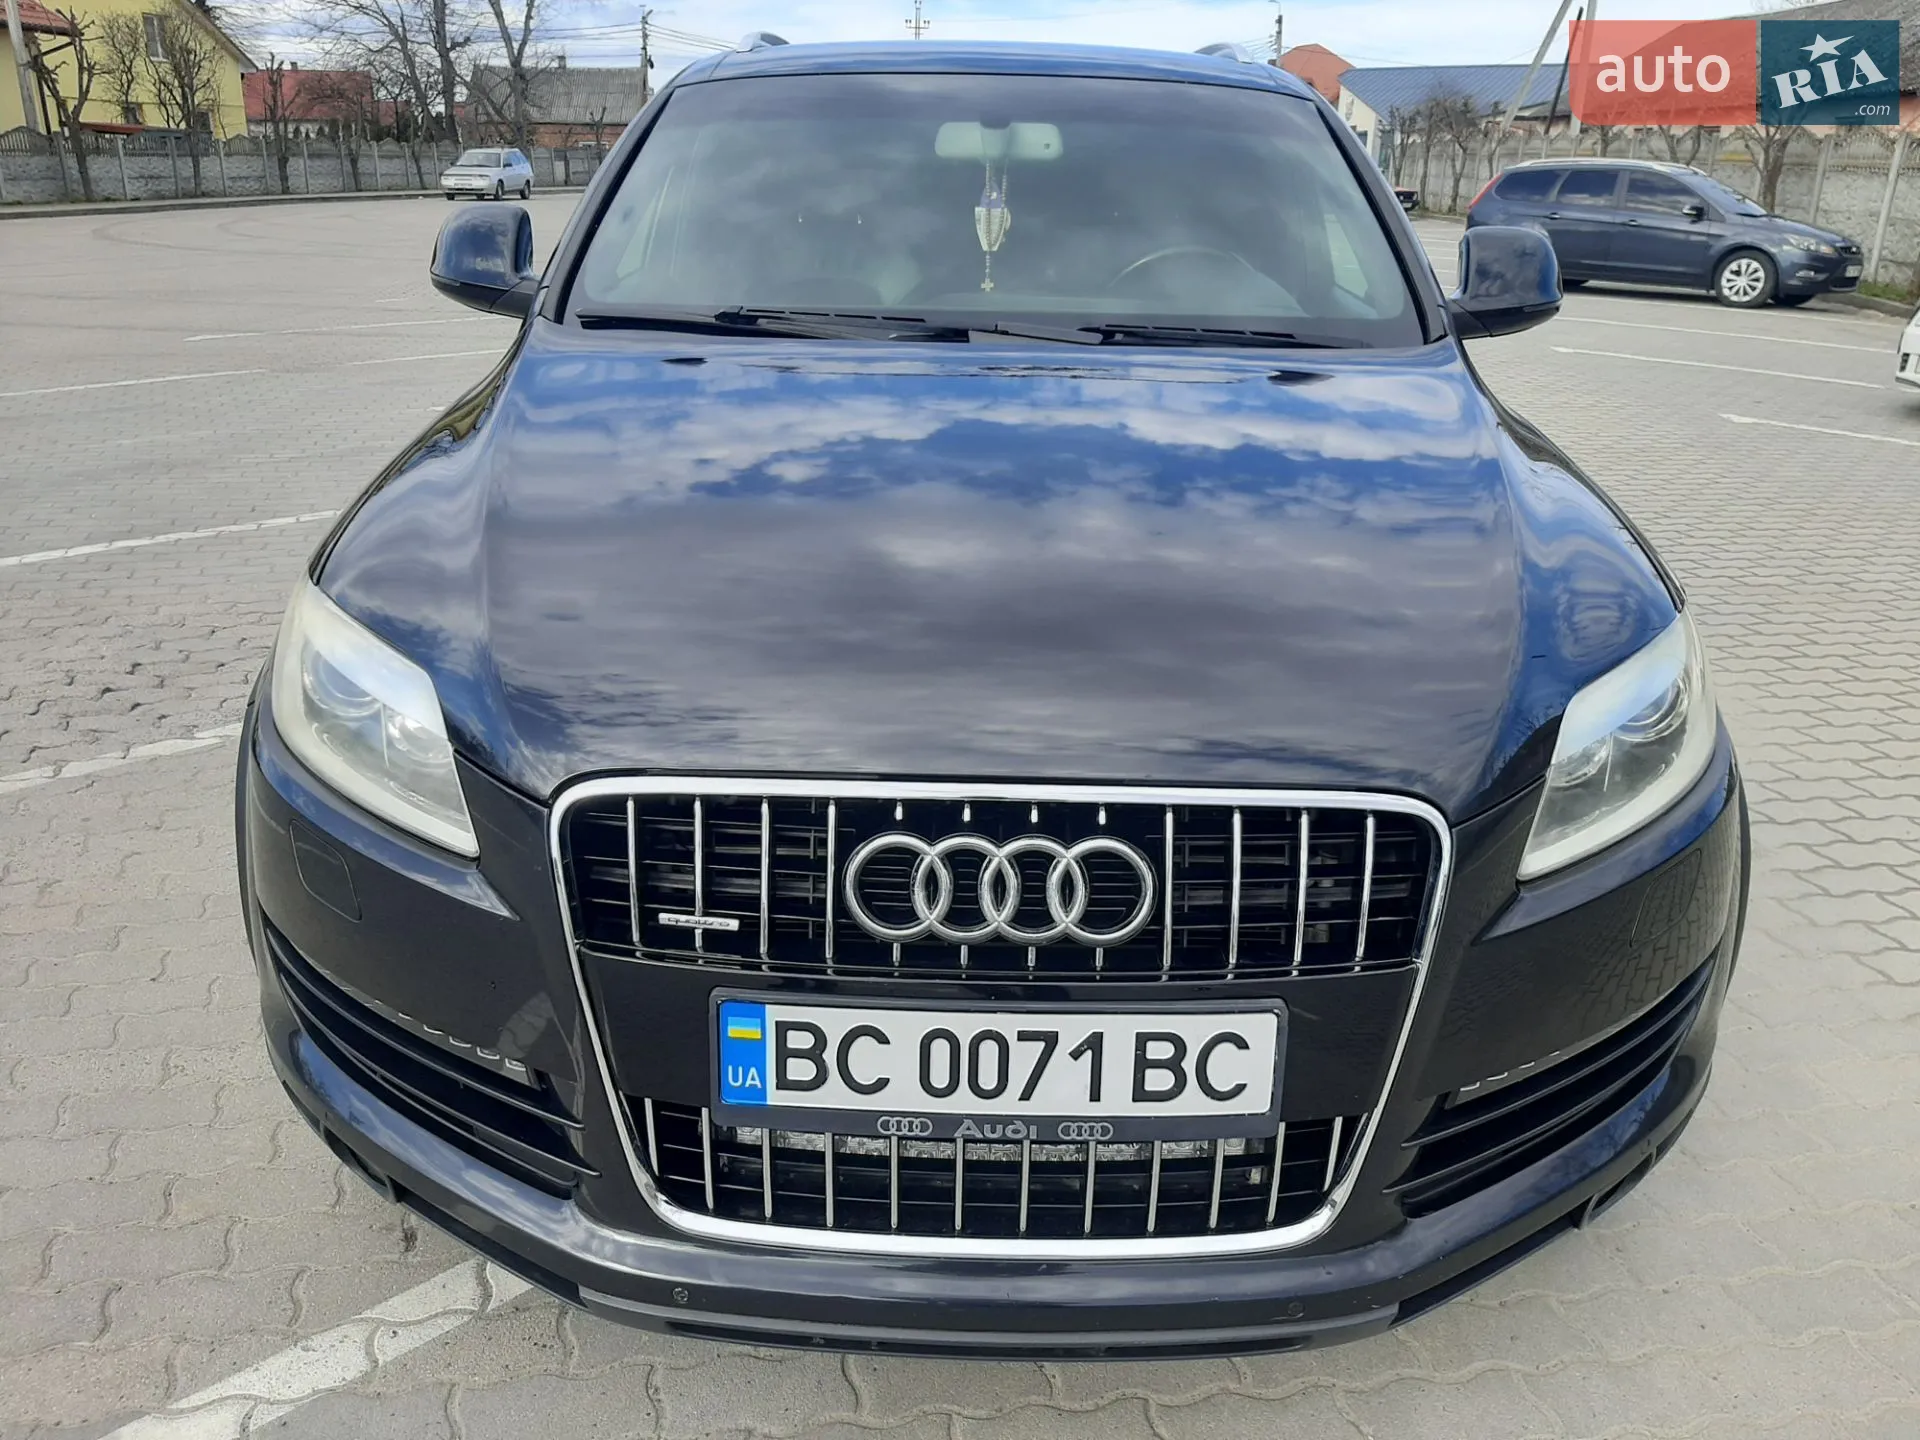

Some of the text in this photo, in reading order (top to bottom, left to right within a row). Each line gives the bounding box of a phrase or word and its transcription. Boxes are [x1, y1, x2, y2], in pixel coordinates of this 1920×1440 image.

[775, 1020, 1251, 1102] BC 0071 BC
[727, 1065, 762, 1089] UA
[953, 1118, 1038, 1139] Audi
